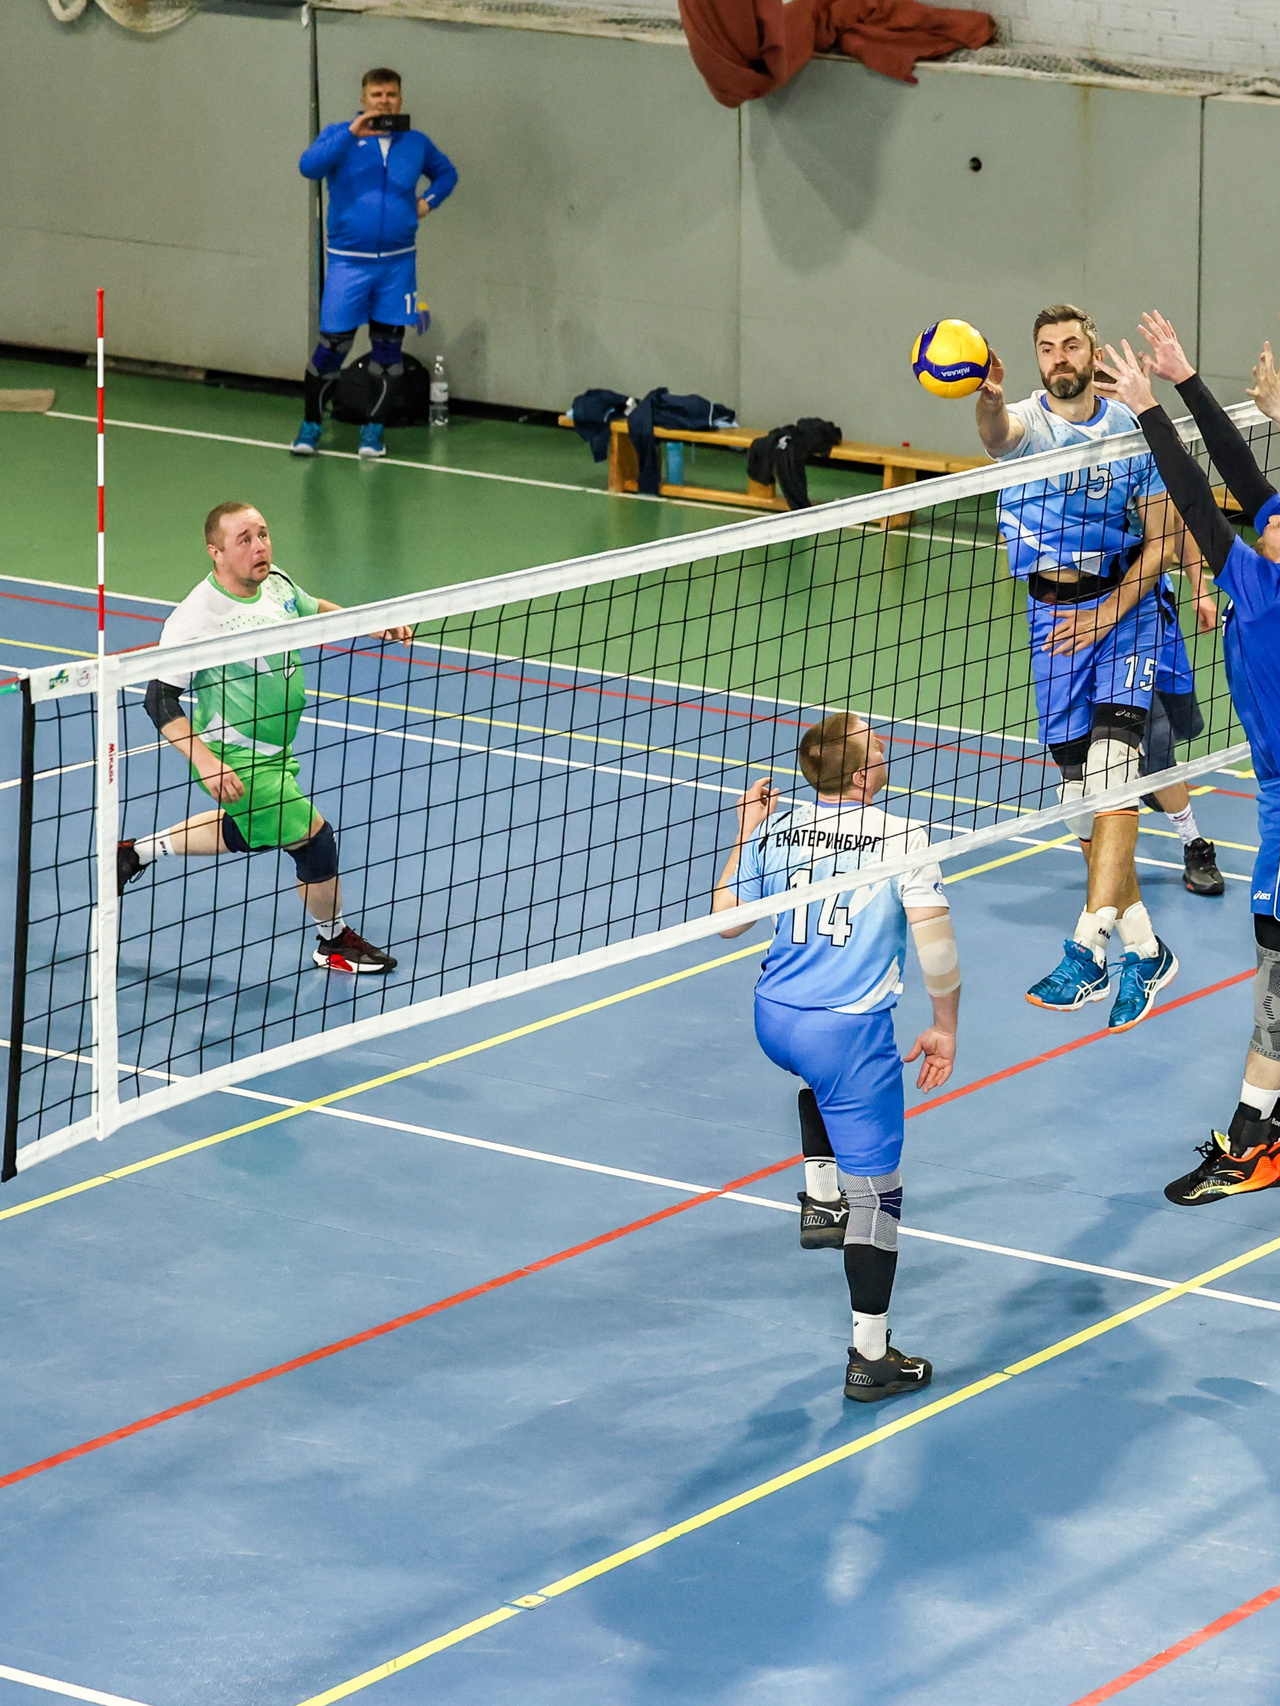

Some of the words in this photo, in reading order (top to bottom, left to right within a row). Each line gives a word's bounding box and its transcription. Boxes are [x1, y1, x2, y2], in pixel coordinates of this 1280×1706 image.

[1124, 655, 1158, 692] 15
[776, 829, 884, 852] ЕКАТЕРИНБУРГ
[788, 868, 853, 947] 14
